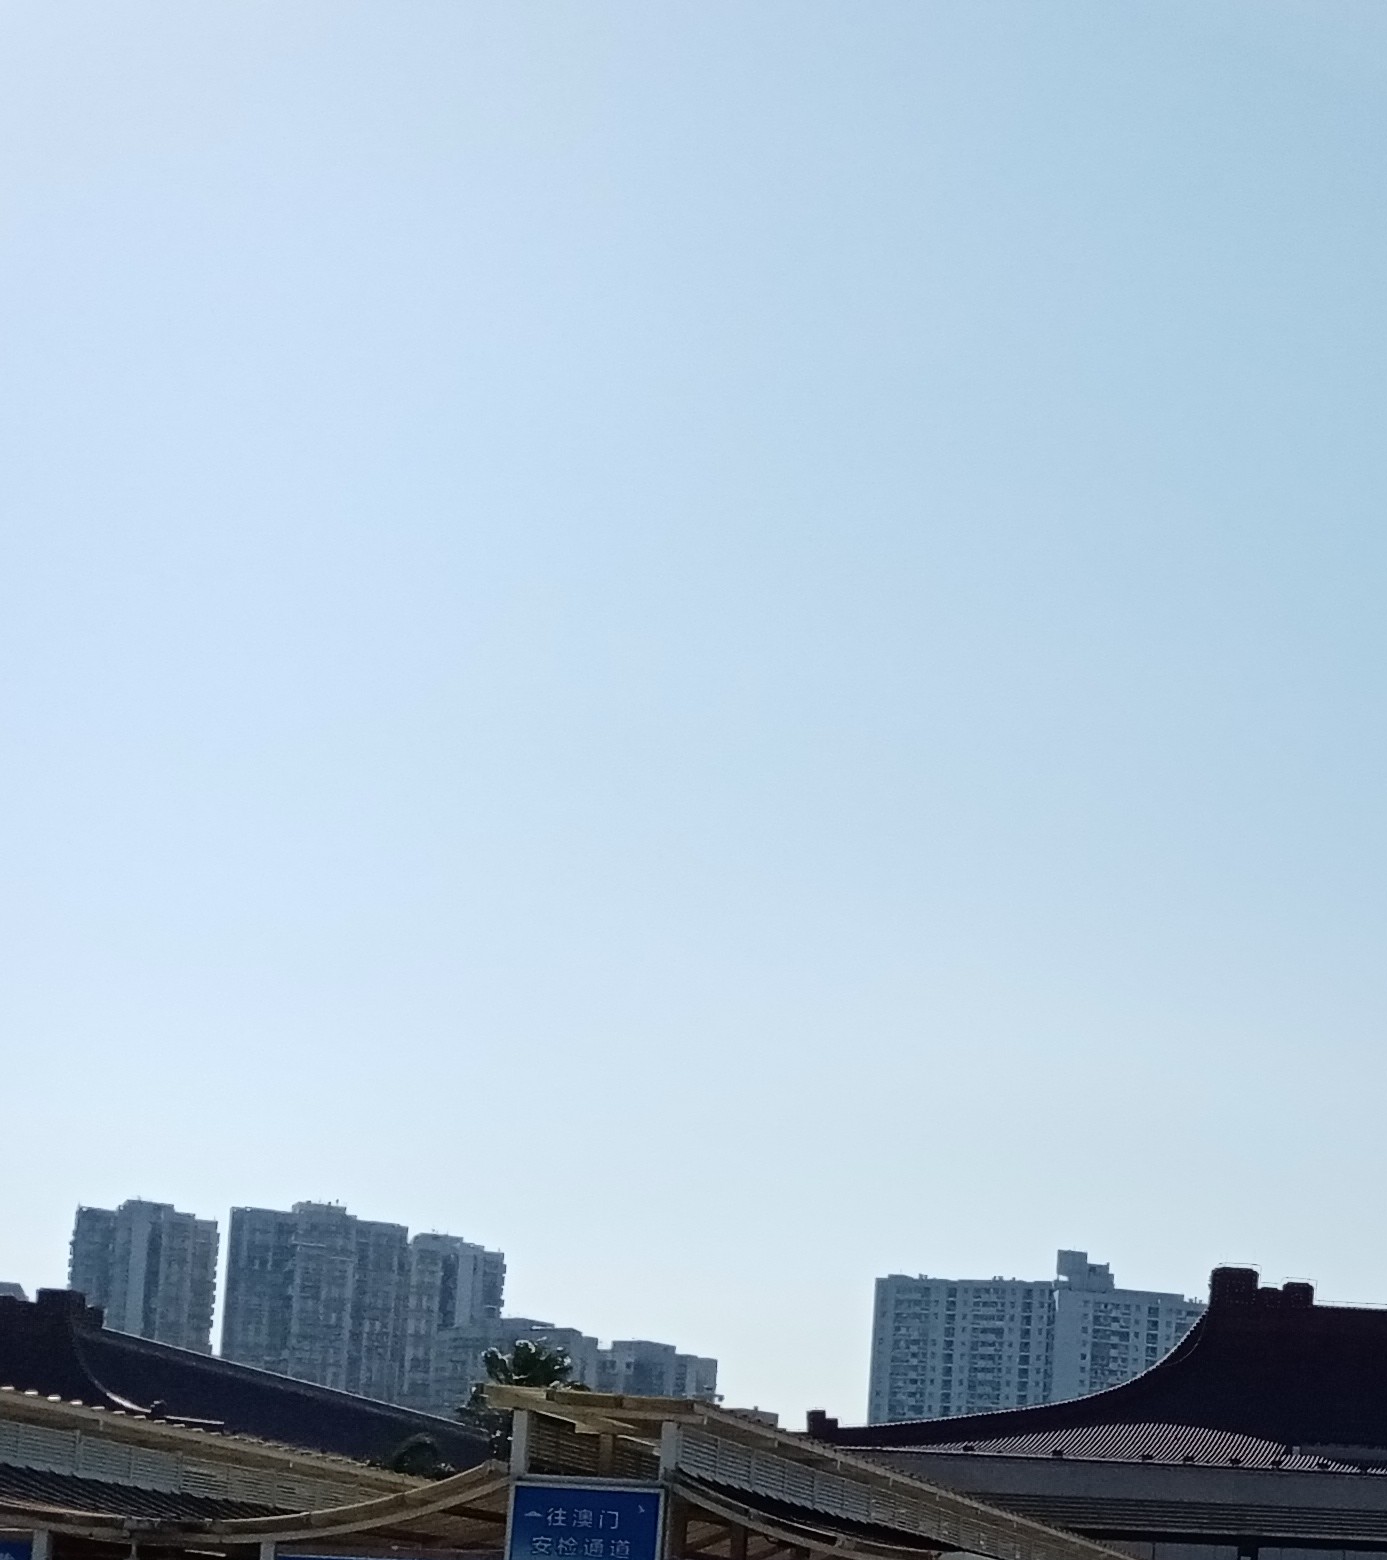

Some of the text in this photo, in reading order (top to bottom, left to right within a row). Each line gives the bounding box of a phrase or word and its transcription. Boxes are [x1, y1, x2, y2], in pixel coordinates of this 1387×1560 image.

[546, 1507, 619, 1530] 往澳门
[531, 1536, 631, 1560] 安检通道
